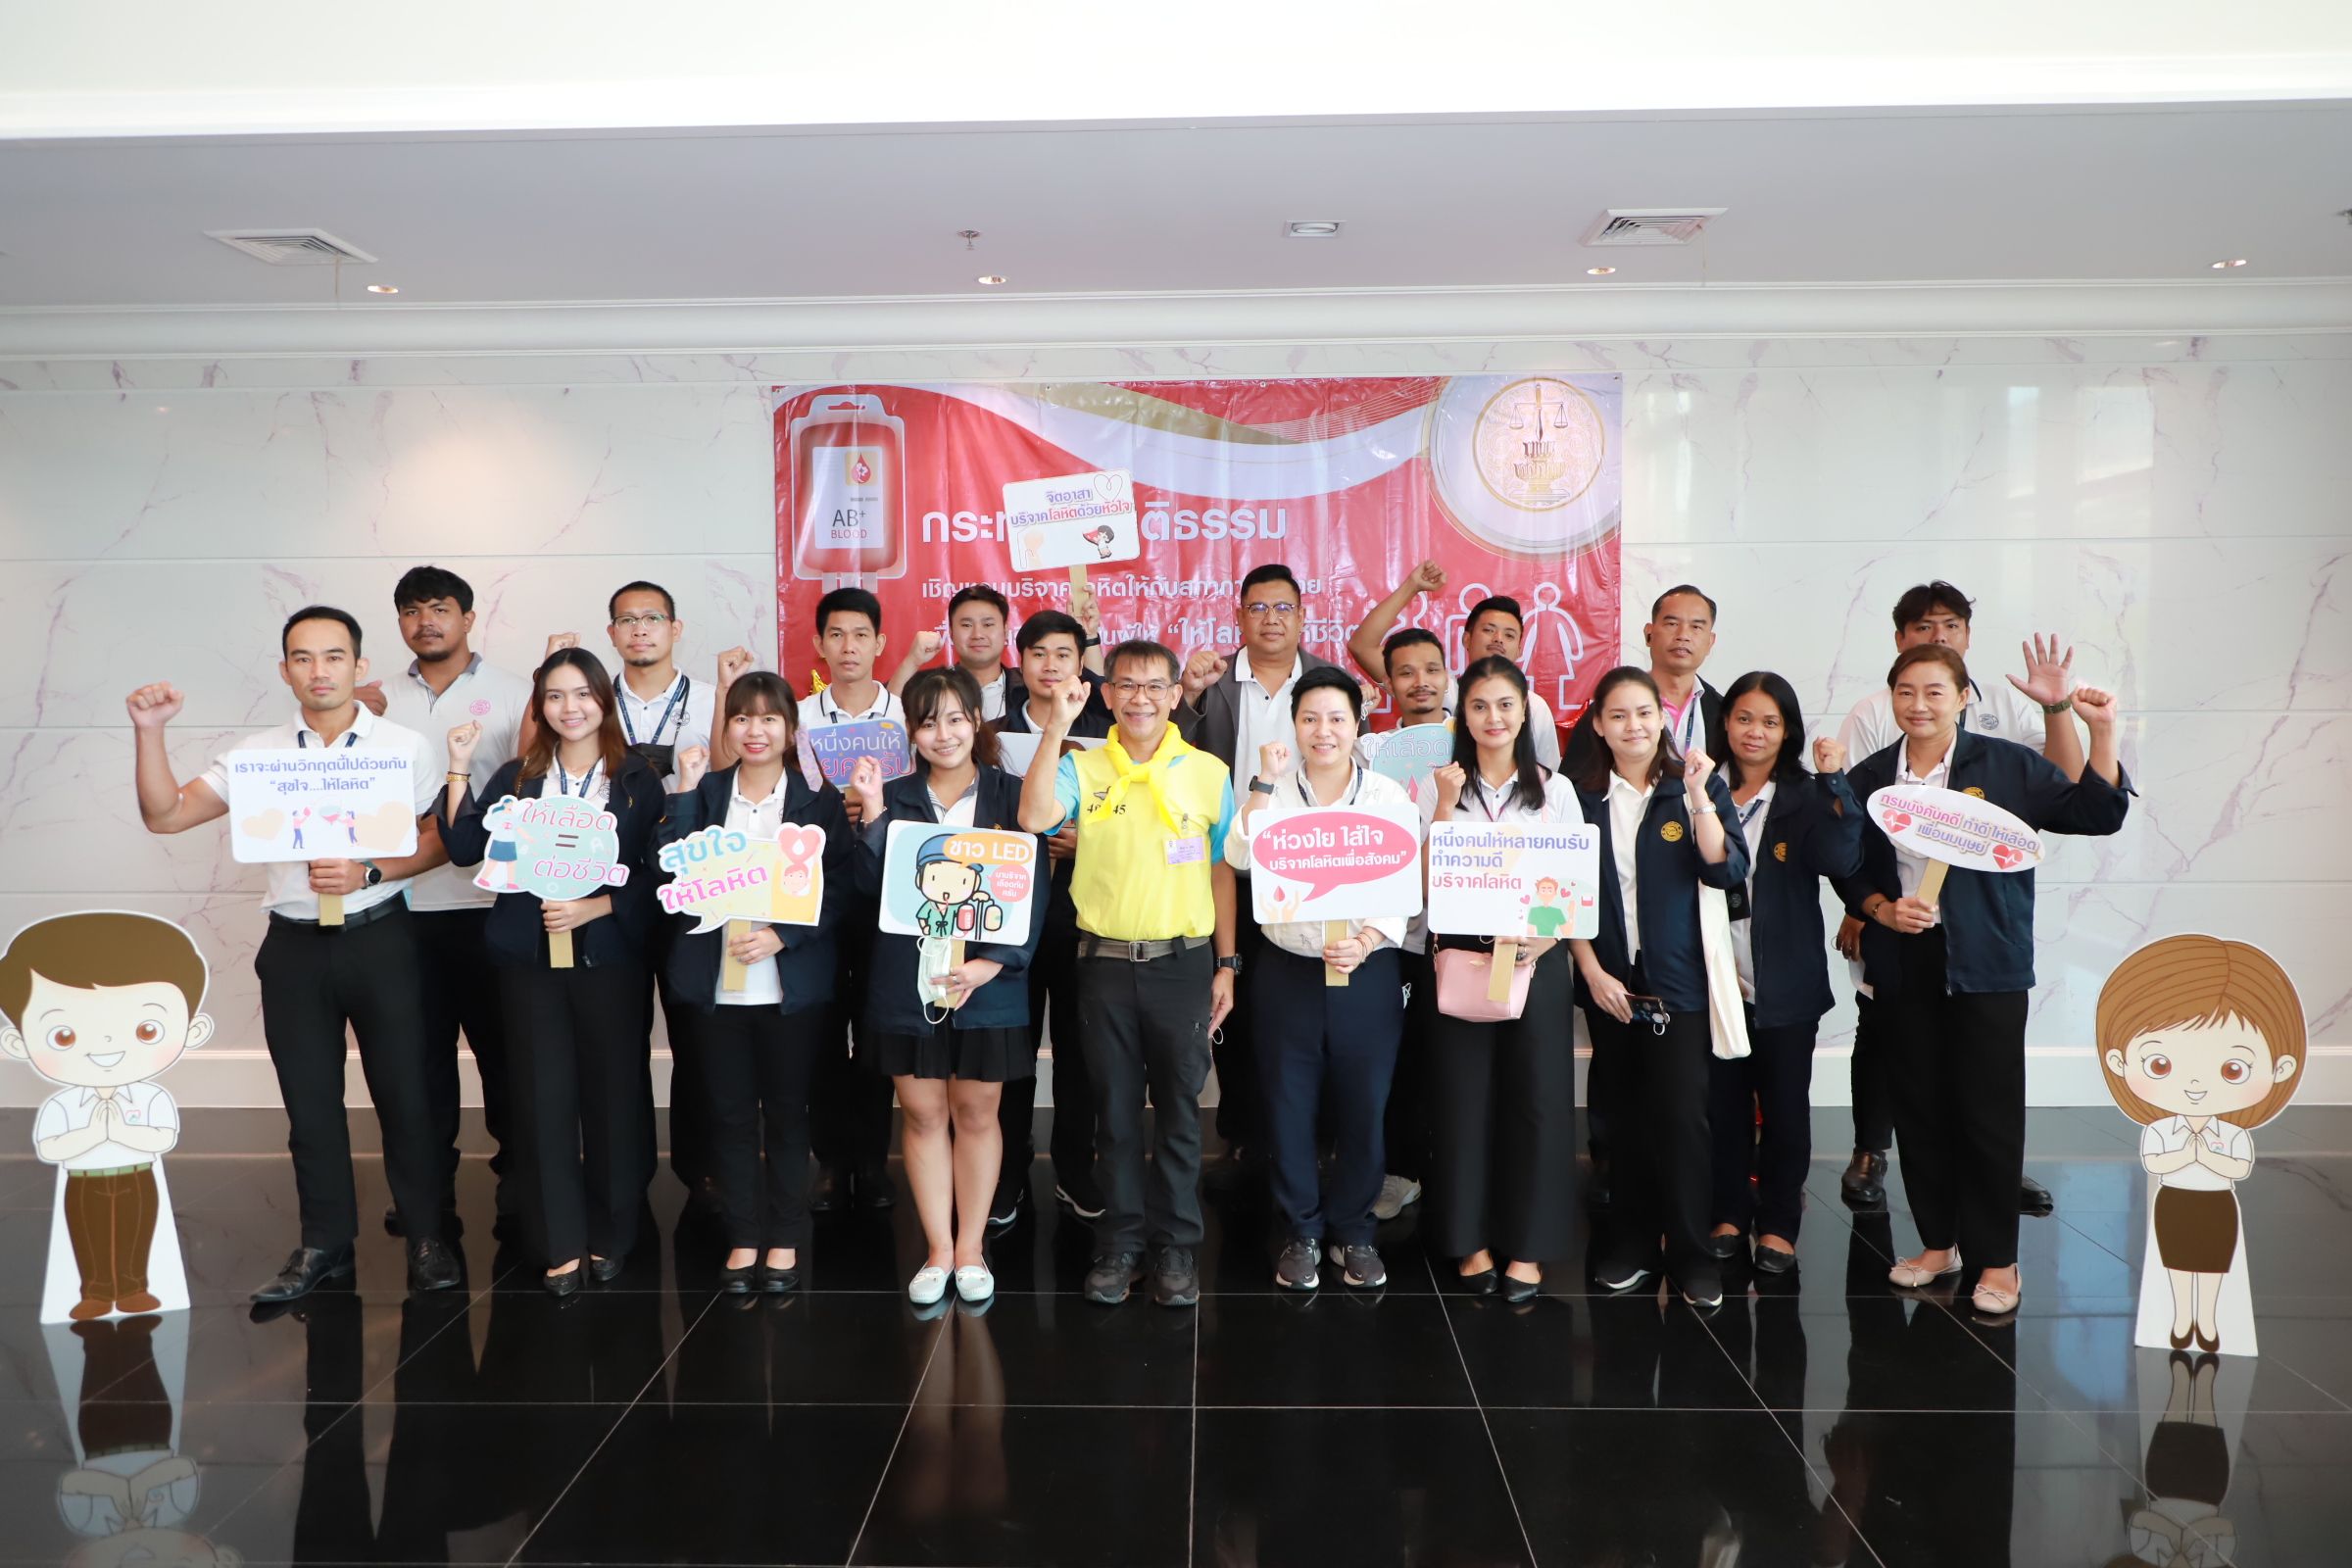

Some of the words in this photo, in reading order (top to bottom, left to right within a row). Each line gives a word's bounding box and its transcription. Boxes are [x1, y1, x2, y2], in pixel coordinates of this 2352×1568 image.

[1046, 488, 1092, 504] จิตอาสา
[1010, 501, 1131, 525] บริจาคโลหิตด้วยหัวใจ
[831, 529, 867, 539] BLOOD
[810, 727, 902, 754] หนึ่งคนให้
[1363, 733, 1450, 759] ให้เลือด
[234, 754, 408, 774] เราจะผ่านวิกฤตนี้ไปด้วยกัน
[521, 801, 614, 831] ให้เลือด
[1112, 804, 1127, 815] 45
[1881, 793, 1960, 826] กรมบังคับคดี
[1432, 826, 1590, 850] หนึ่งคนให้หลายคนรับ
[1918, 820, 1989, 854] เพื่อนมนุษย์
[663, 828, 747, 875] สุขใจ
[949, 840, 986, 858] ชาว
[992, 842, 1030, 861] LED
[1432, 850, 1503, 868] ทำความดี
[533, 855, 627, 884] ต่อชีวิต
[1432, 872, 1522, 890] บริจาคโลหิต
[659, 866, 768, 910] ให้โลหิต
